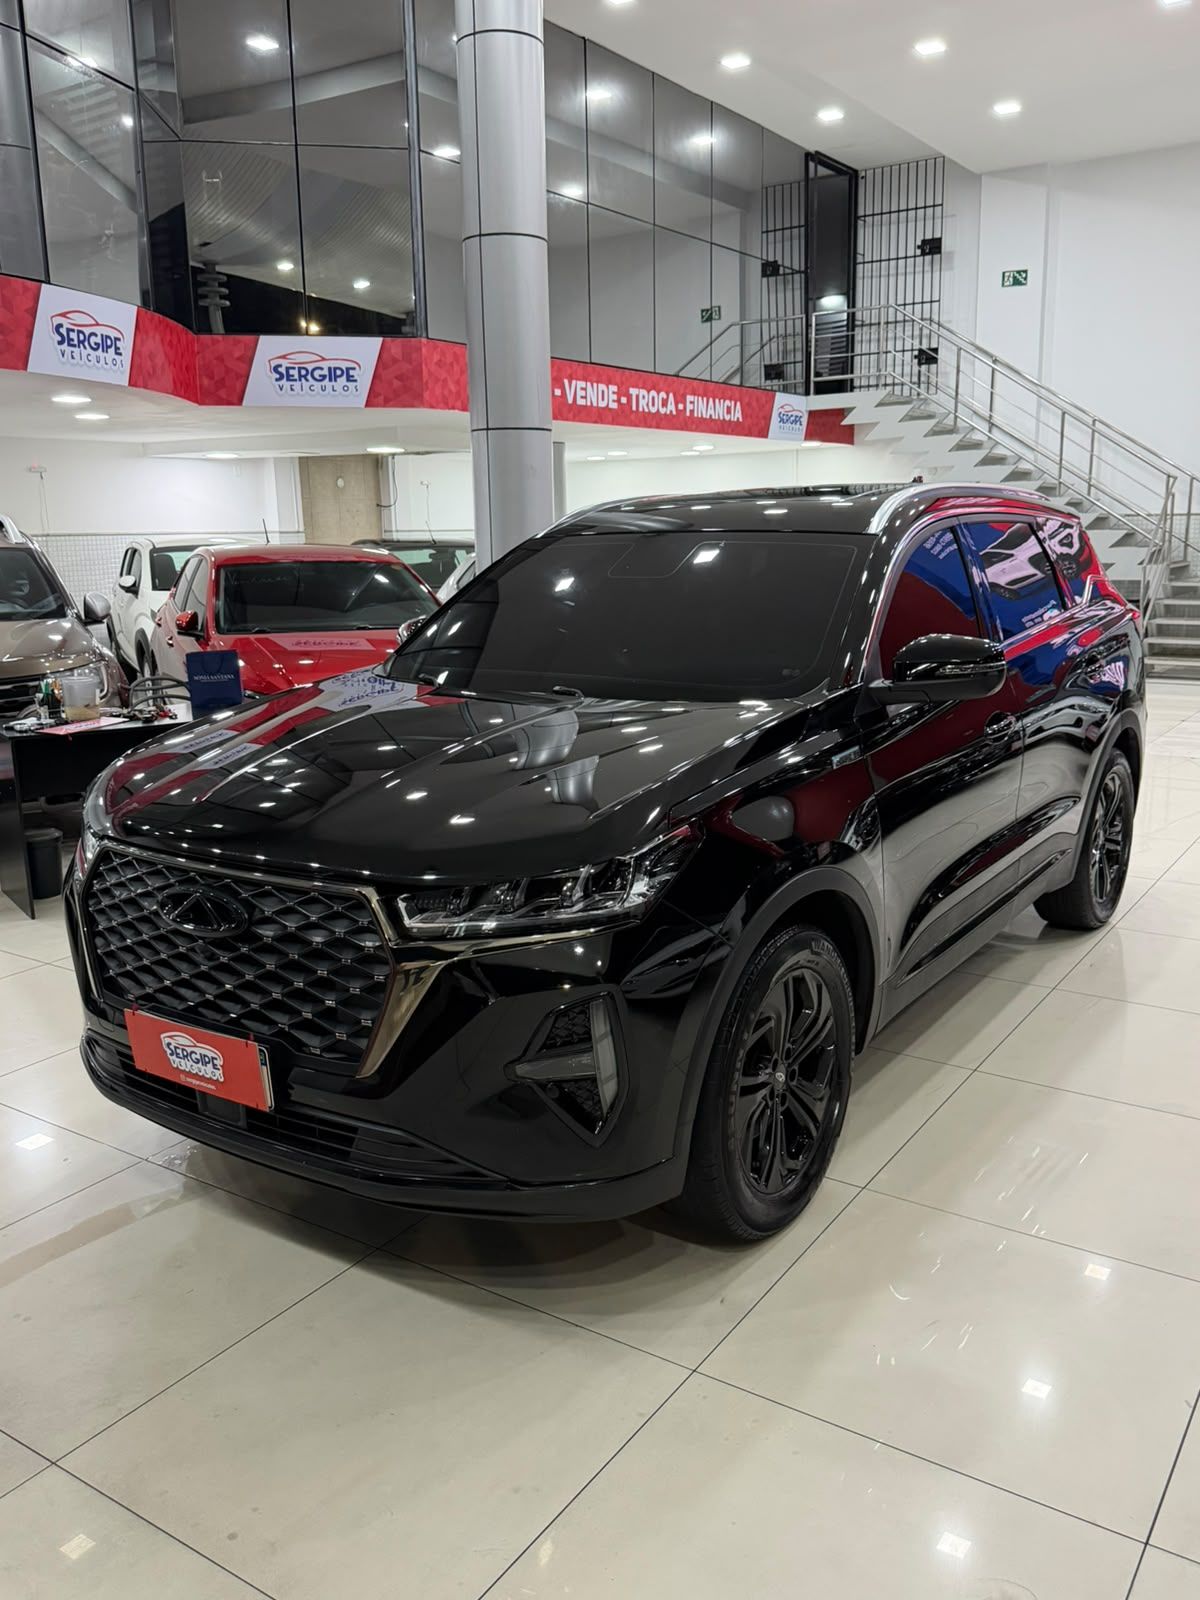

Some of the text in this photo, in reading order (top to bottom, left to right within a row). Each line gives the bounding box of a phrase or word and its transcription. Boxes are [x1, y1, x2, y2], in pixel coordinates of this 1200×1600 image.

[55, 322, 122, 356] SERGIPE
[60, 348, 124, 368] VEÍCULOS
[273, 364, 358, 383] SERGIPE
[278, 382, 359, 392] VEÍCULOS
[564, 379, 618, 409] VENDE
[629, 387, 676, 415] TROCA
[686, 394, 742, 422] FINANCIA
[166, 1042, 220, 1070] SERGIPE
